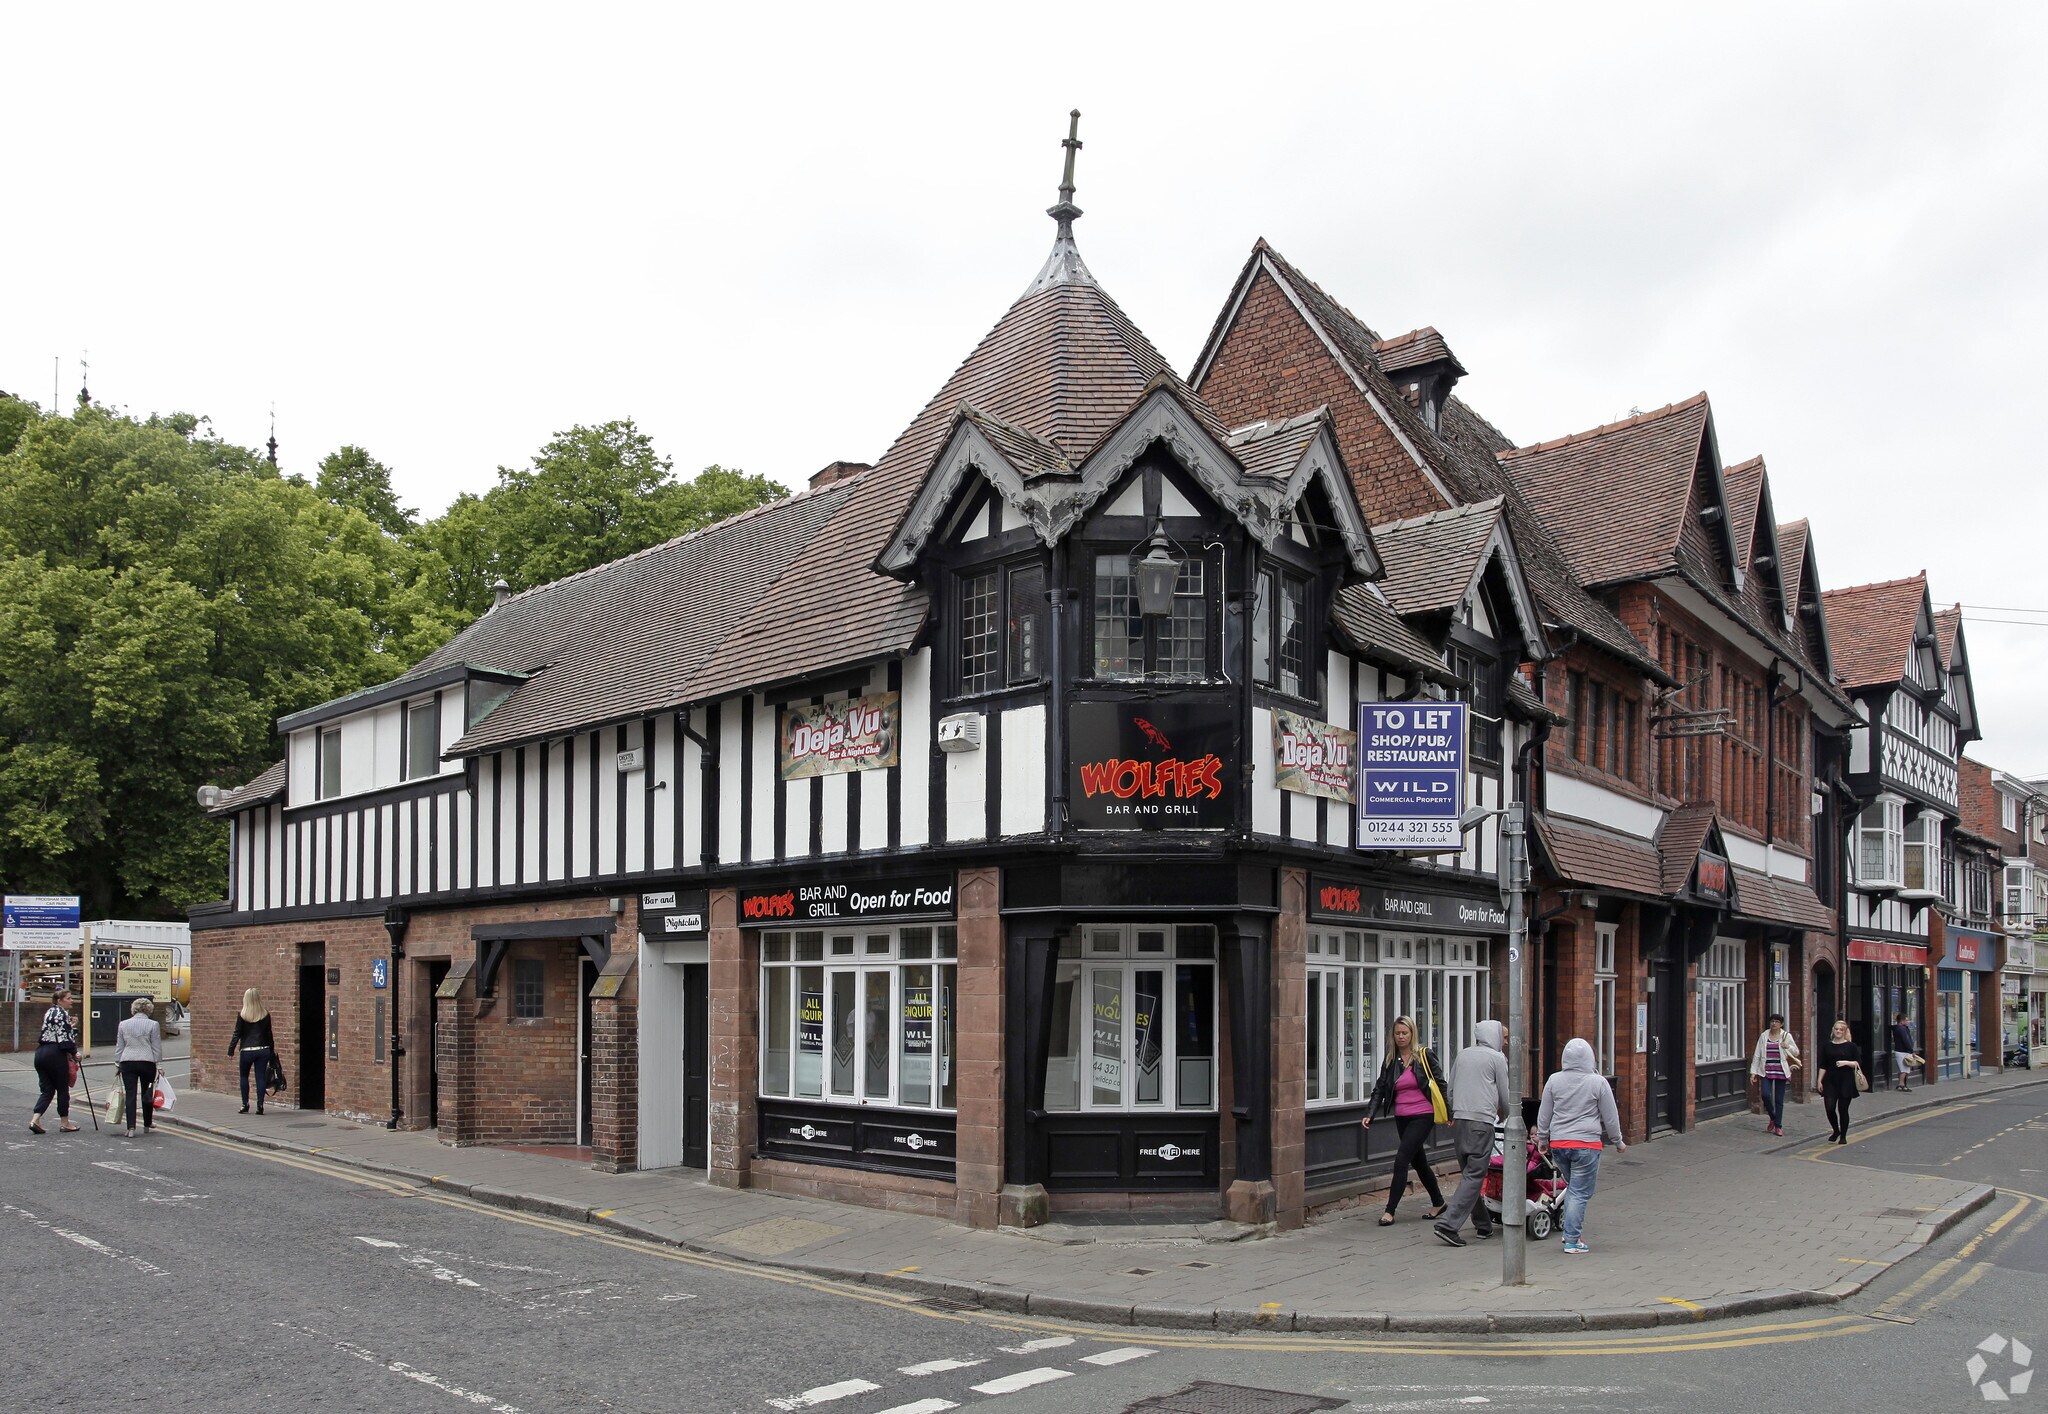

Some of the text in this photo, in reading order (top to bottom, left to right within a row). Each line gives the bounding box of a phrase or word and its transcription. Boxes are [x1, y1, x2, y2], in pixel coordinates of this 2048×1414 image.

[1373, 710, 1451, 729] TO LET
[794, 704, 880, 758] Deja Vu
[1371, 735, 1452, 748] SHOP/PUB/
[829, 751, 840, 759] Bar
[847, 746, 864, 757] Night
[865, 745, 880, 754] Club
[1283, 733, 1347, 771] Deja Vu
[1367, 750, 1456, 762] RESTAURANT
[1081, 754, 1222, 799] WOLFIE'S
[1311, 771, 1320, 780] Bar
[1373, 781, 1449, 792] WILD
[1106, 805, 1199, 814] BAR AND GRILL
[1368, 822, 1453, 833] 01244 321 555
[1374, 835, 1447, 844] www.wildcp.co.uk
[800, 885, 847, 901] BAR AND
[1320, 886, 1361, 913] WOLFIE'S
[644, 895, 674, 905] Bar and
[743, 890, 795, 918] WOLFIE'S
[850, 886, 952, 914] Open for Food
[809, 903, 840, 916] GRILL
[1384, 898, 1432, 916] BAR AND GRILL
[1459, 905, 1506, 924] Open for Food
[666, 918, 699, 930] Nightclub
[806, 998, 819, 1009] ALL
[914, 993, 929, 1004] ALL
[800, 1032, 823, 1040] WIL
[1104, 1064, 1119, 1075] 321
